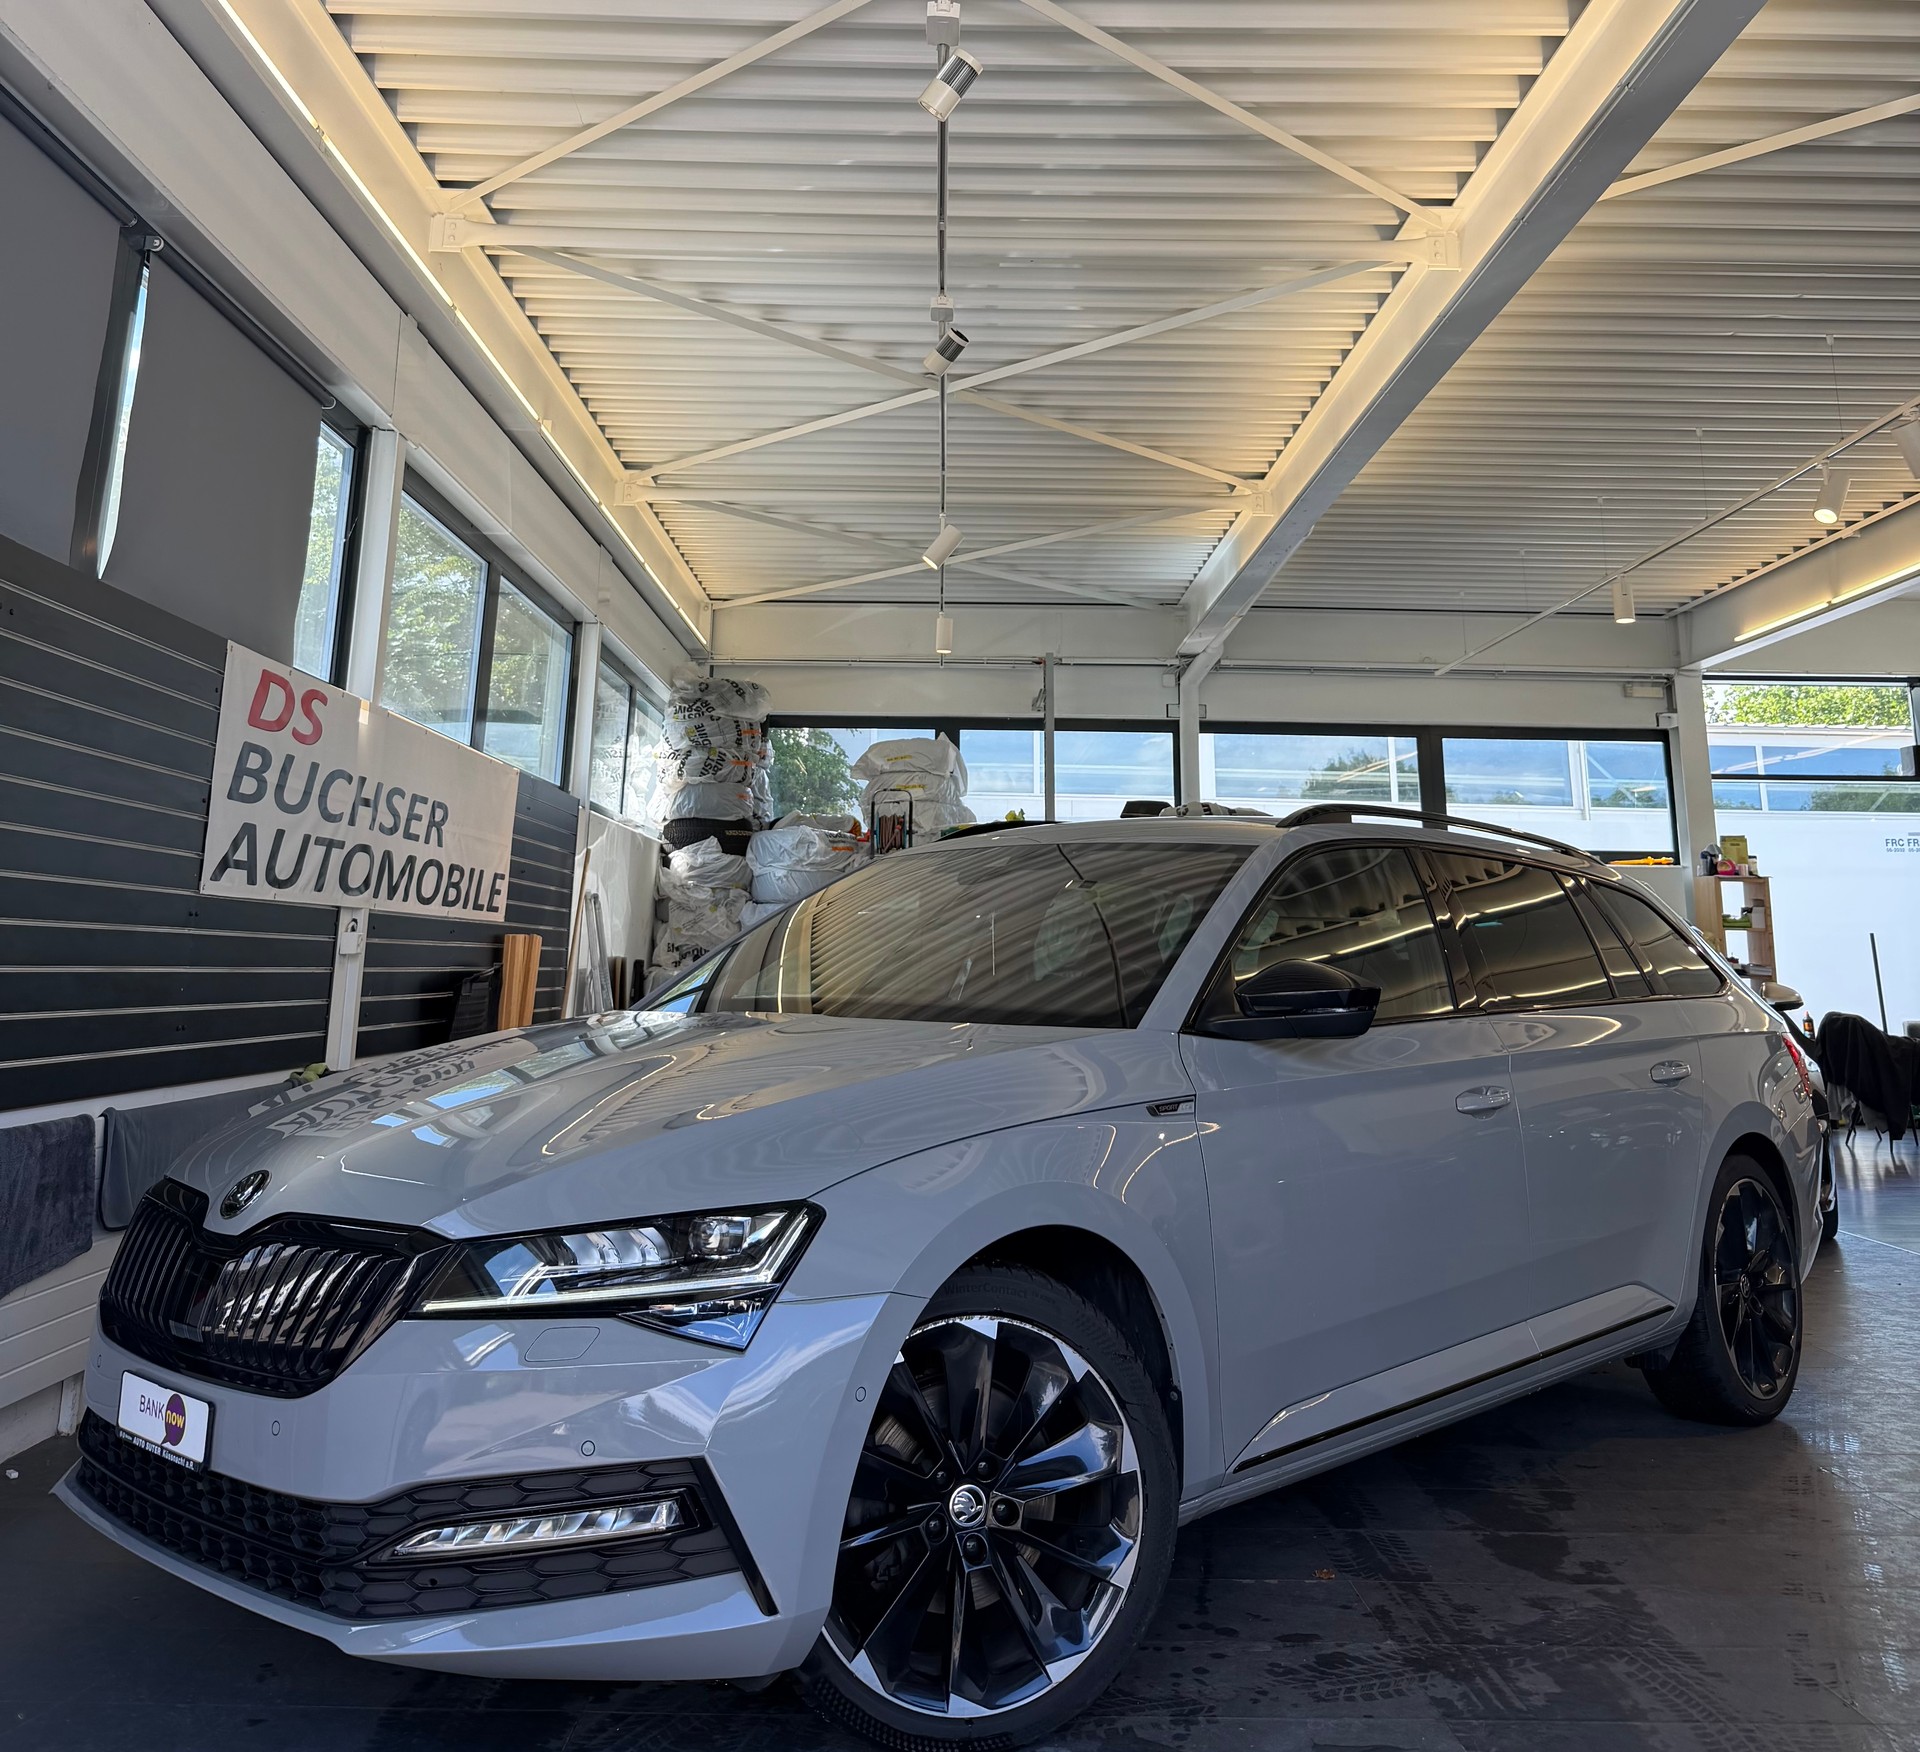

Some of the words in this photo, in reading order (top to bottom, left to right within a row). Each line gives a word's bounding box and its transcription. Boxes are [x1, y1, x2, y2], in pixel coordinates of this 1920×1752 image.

[248, 669, 328, 745] DS
[227, 741, 449, 847] BUCHSER
[1885, 838, 1905, 847] FRC
[209, 821, 506, 913] AUTOMOBILE
[944, 1282, 1028, 1299] WinterContact
[139, 1394, 165, 1421] BANK
[166, 1410, 185, 1428] now
[132, 1436, 146, 1449] AUTO
[145, 1441, 162, 1456] SUTER
